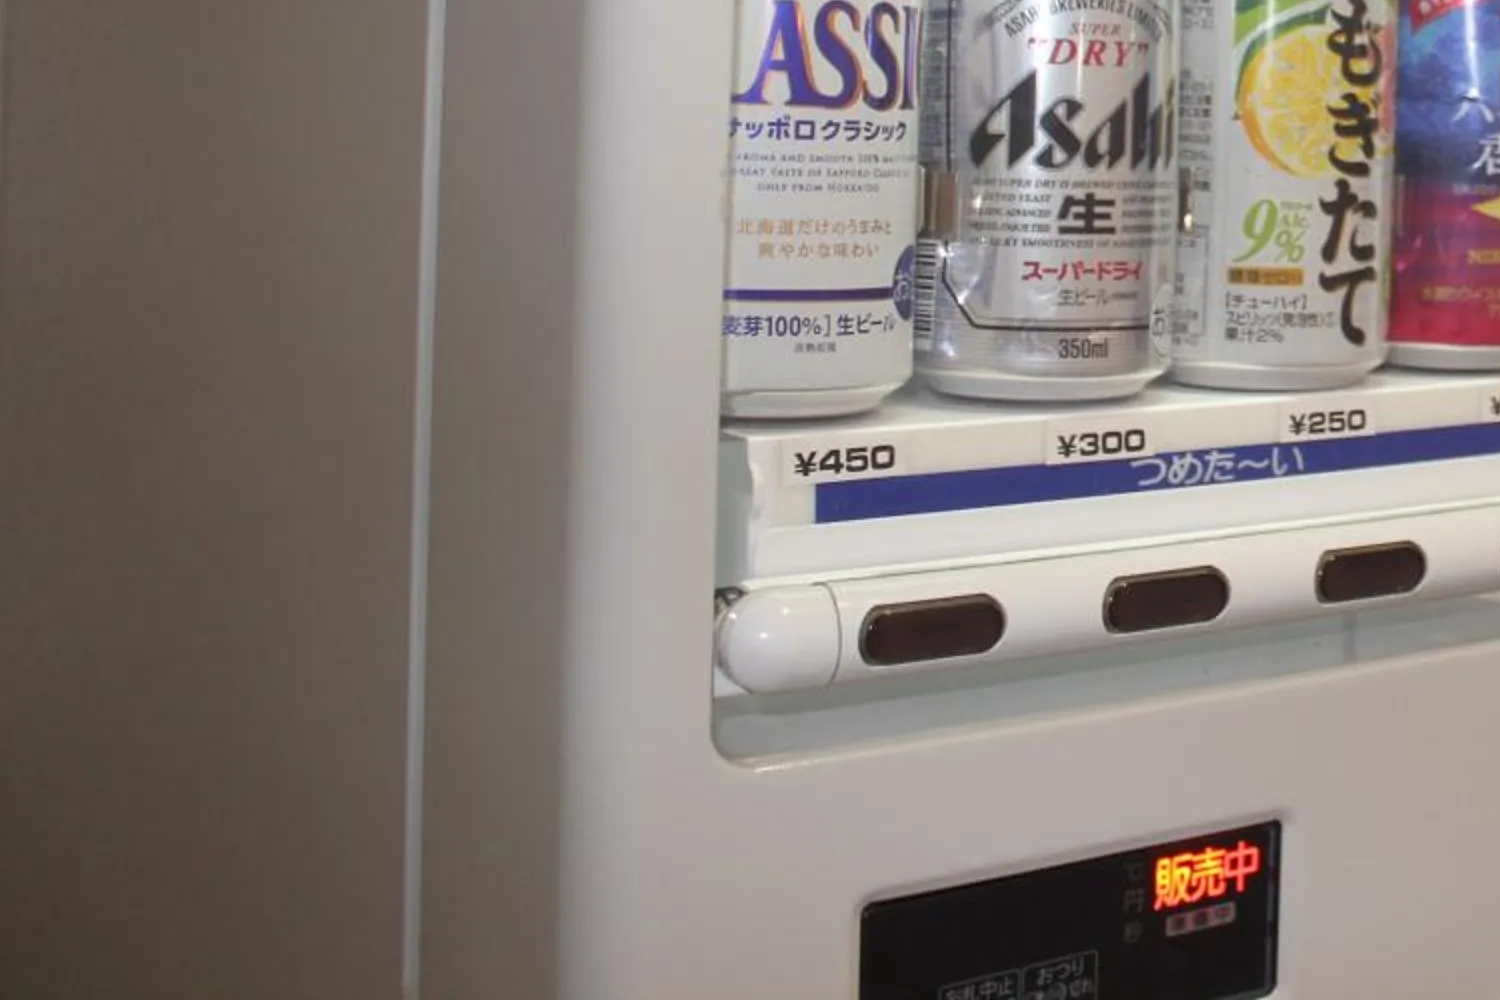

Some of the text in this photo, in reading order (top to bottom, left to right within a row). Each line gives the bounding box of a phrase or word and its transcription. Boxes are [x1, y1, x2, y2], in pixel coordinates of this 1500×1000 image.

[1004, 4, 1038, 39] ASAH
[1058, 192, 1116, 235] 生
[1021, 260, 1142, 282] スーパードライ
[1058, 337, 1109, 359] 350ml
[1289, 408, 1367, 435] ¥250
[1057, 429, 1146, 459] ¥300
[794, 444, 896, 477] ¥450
[1153, 840, 1260, 911] 販売中
